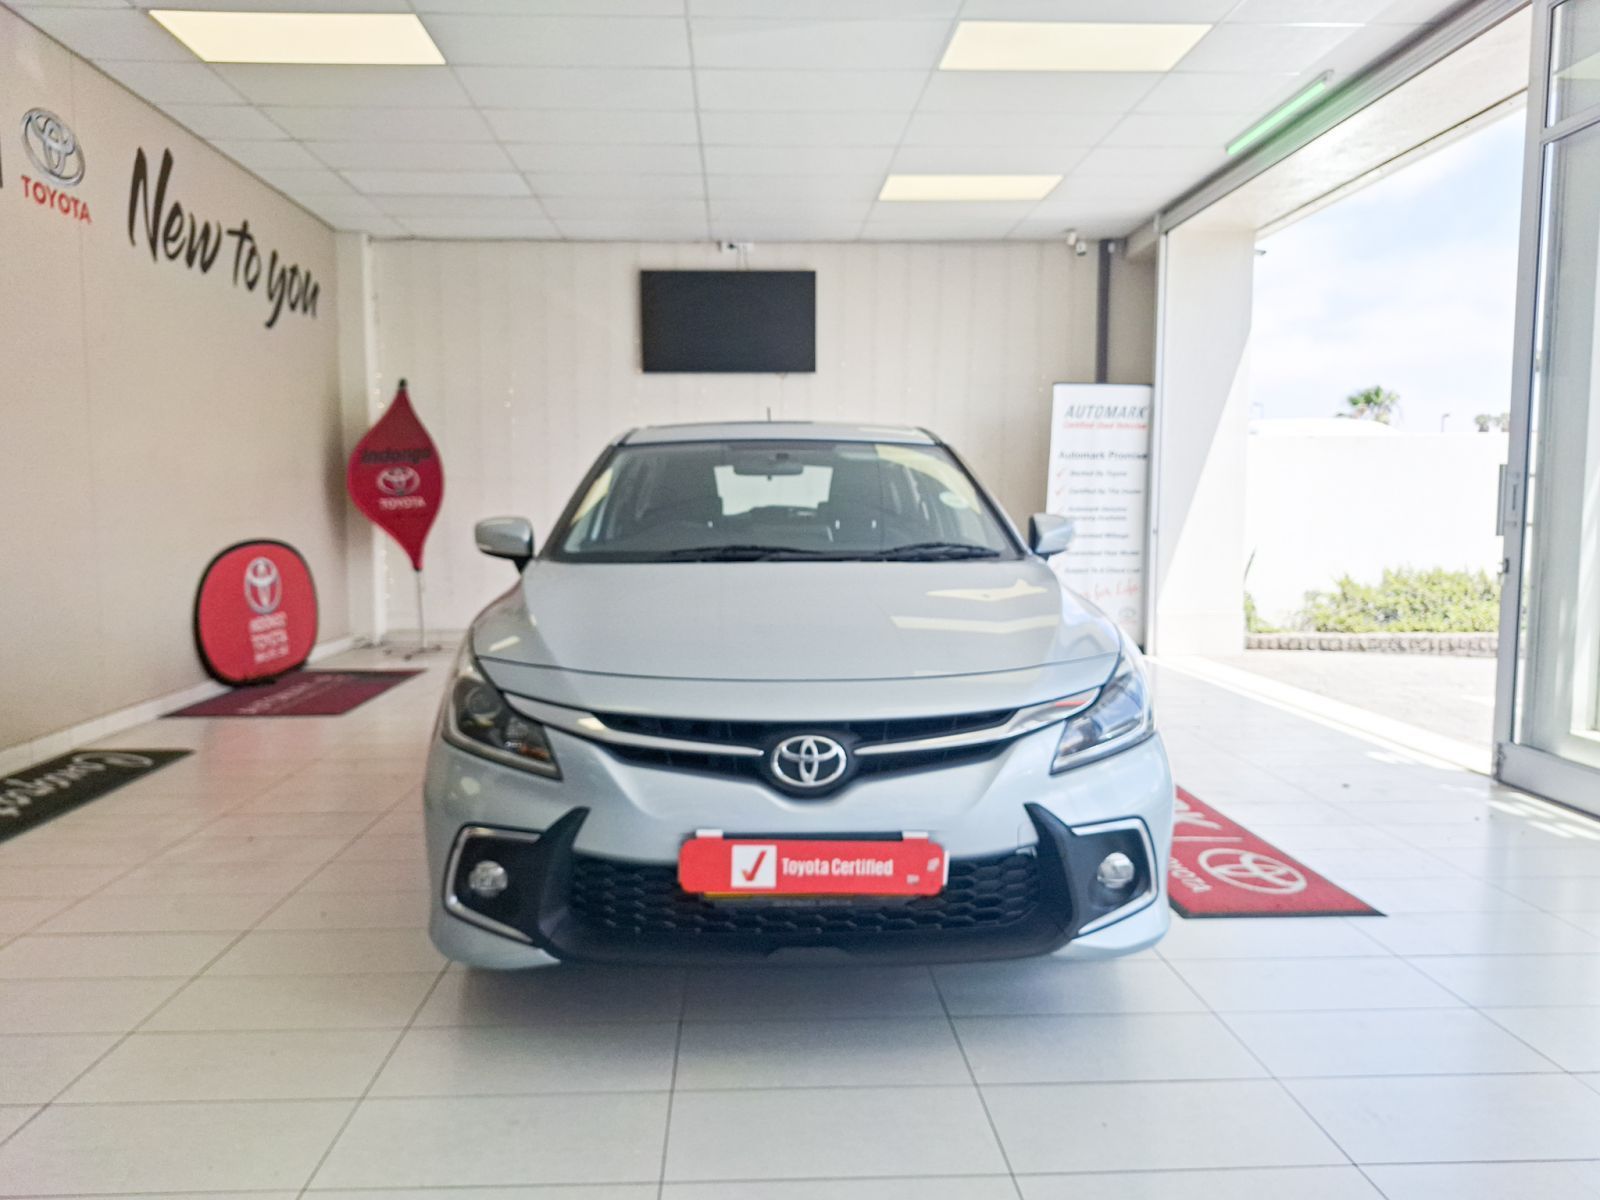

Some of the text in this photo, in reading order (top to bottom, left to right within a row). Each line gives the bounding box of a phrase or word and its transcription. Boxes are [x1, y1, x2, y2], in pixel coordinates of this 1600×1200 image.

[21, 175, 92, 224] TOYOTA
[129, 147, 320, 329] New to you
[1065, 405, 1148, 418] AUTOMARK
[1058, 451, 1105, 460] Automark
[782, 857, 893, 877] Toyota Certified
